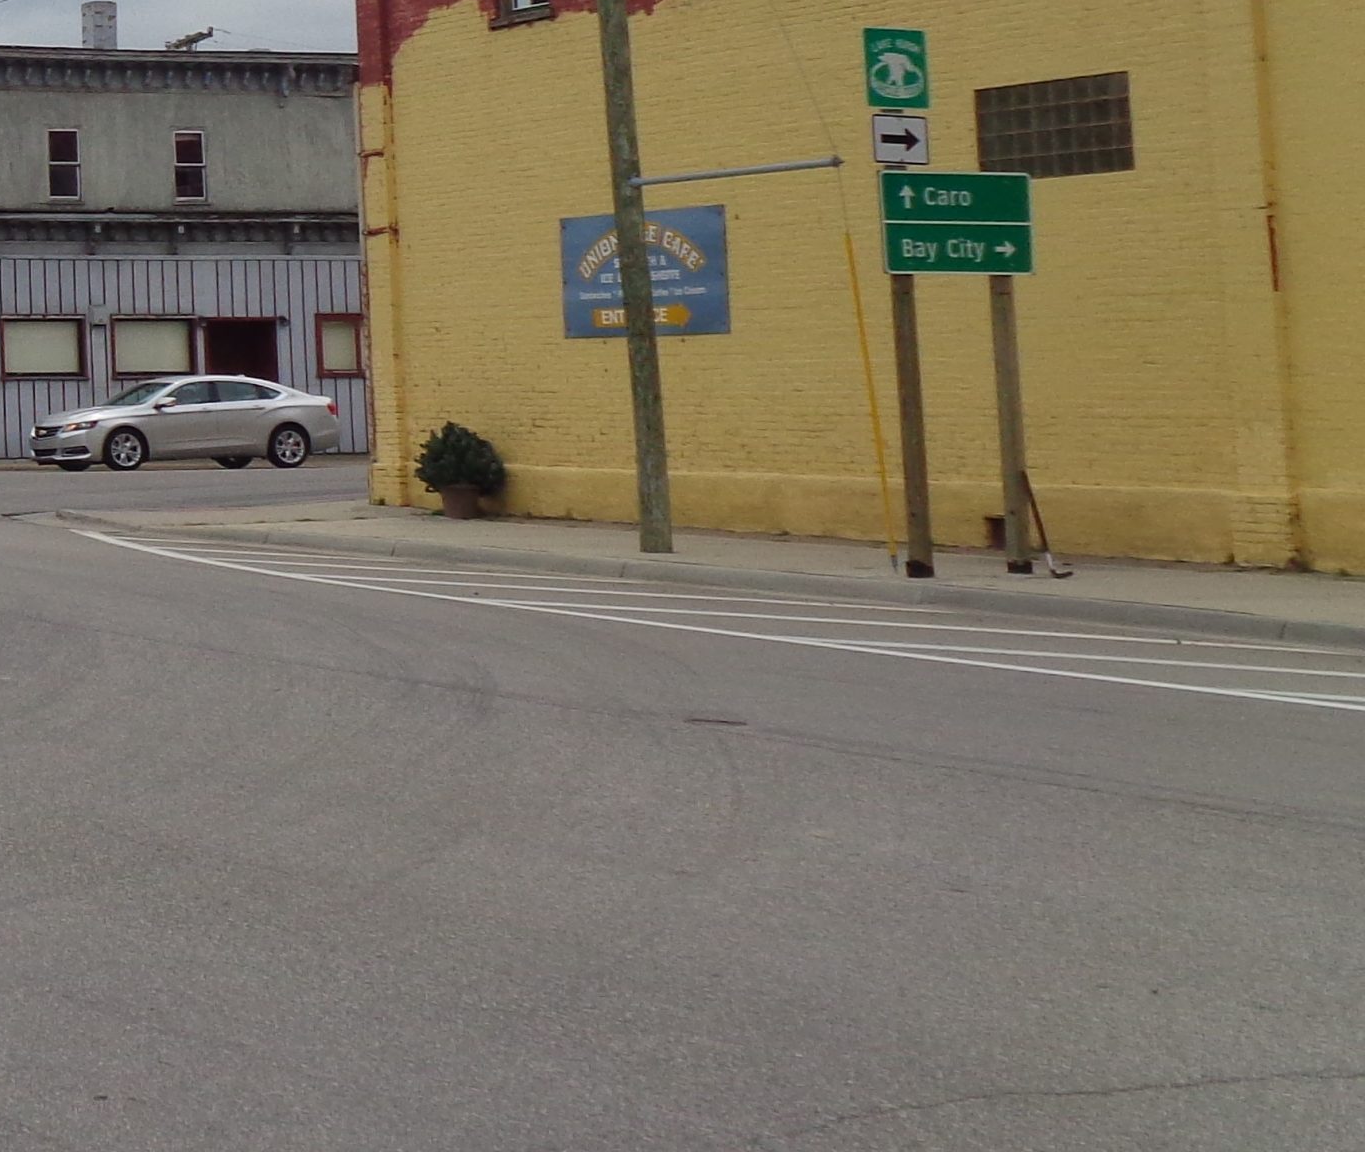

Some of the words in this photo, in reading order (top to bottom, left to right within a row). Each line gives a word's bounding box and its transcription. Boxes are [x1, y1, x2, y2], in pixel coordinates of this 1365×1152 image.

[924, 187, 971, 206] Caro
[901, 238, 938, 263] Bay
[946, 237, 986, 263] City
